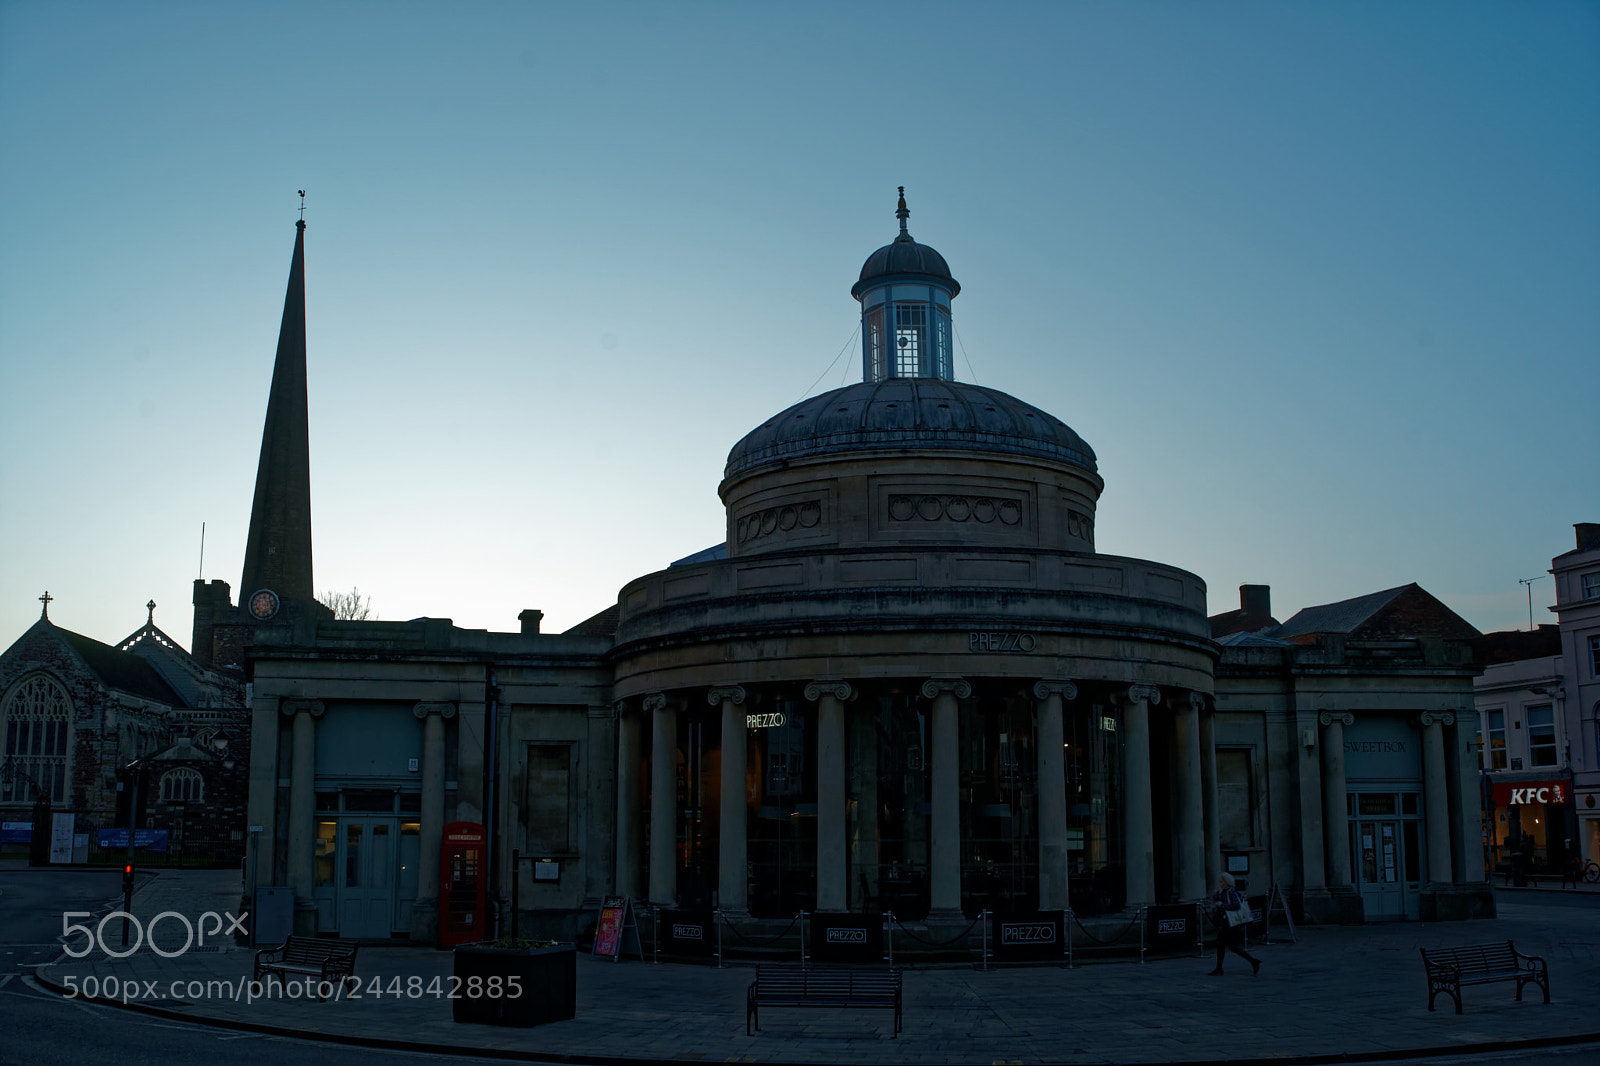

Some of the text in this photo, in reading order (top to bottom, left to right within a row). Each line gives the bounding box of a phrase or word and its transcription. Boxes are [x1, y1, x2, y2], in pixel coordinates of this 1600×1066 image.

[969, 631, 1036, 652] PREZZO
[746, 712, 785, 729] PREZZO
[1343, 741, 1407, 753] SWEETBOX
[1509, 787, 1550, 805] KFC
[674, 926, 701, 938] PREZZO
[1159, 921, 1185, 932] PREZZO
[829, 930, 864, 941] PREZZO
[1004, 926, 1053, 942] PREZZO
